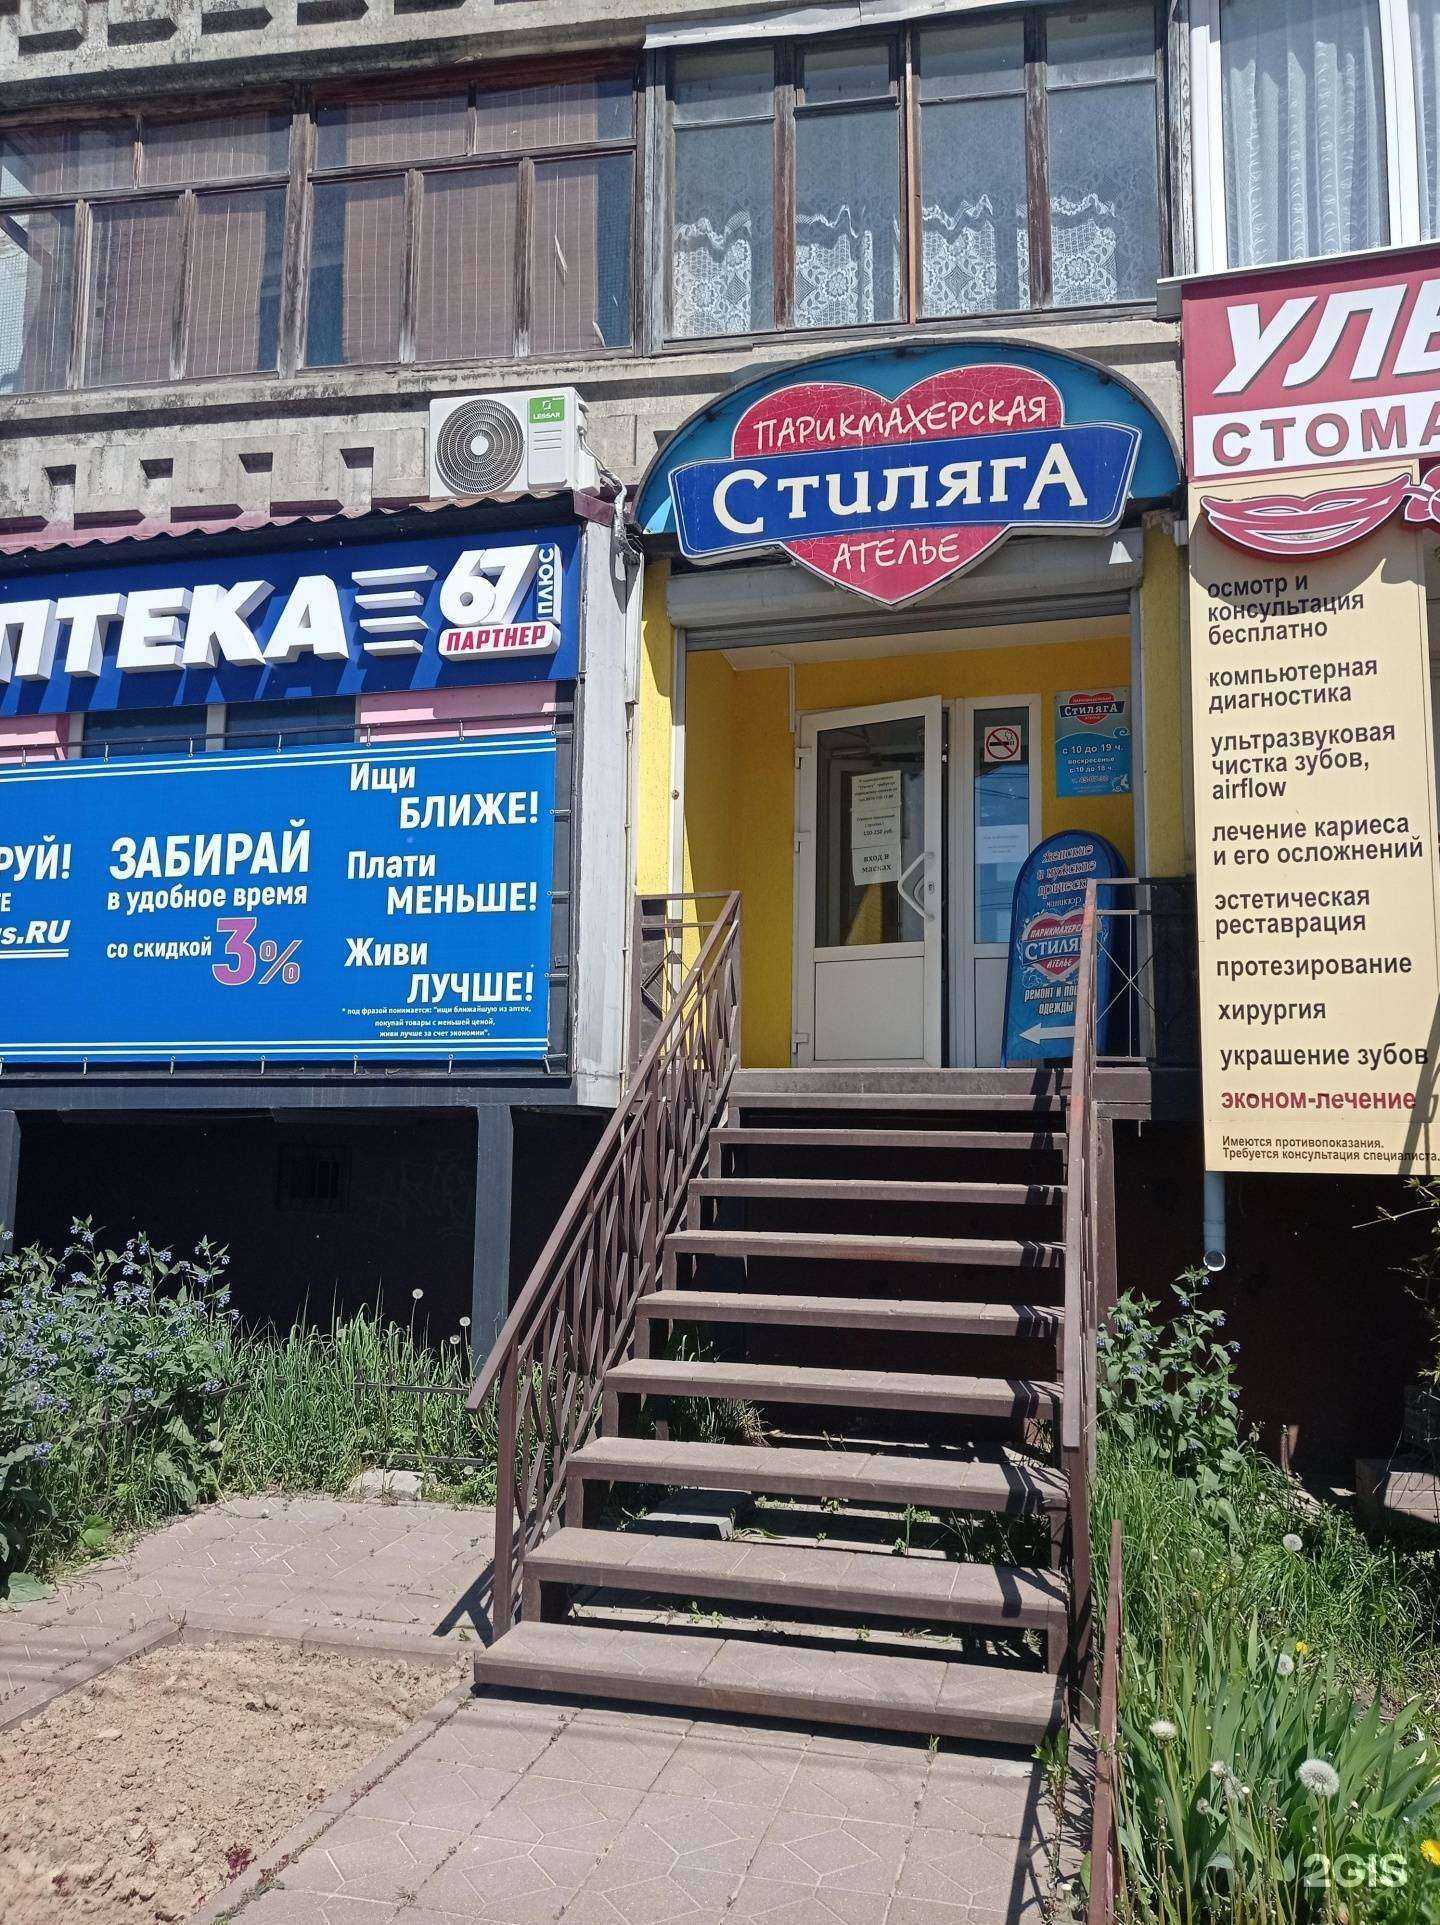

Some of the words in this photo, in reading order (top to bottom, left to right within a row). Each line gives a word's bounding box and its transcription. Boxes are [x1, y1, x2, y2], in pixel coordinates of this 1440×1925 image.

[533, 412, 561, 420] LESSAR
[752, 395, 1048, 451] ПАРИКМАХЕРСКАЯ
[833, 534, 960, 575] АТЕЛЬЕ
[440, 544, 539, 629] 67
[537, 547, 555, 616] ПЛЮС
[1208, 577, 1288, 598] осмотр
[1295, 575, 1308, 591] и
[1208, 593, 1364, 623] консультация
[446, 625, 546, 652] ПАРТНЕР
[1208, 621, 1328, 646] бесплатно
[1209, 659, 1378, 688] компьютерная
[1208, 685, 1352, 714] диагностика
[1071, 746, 1082, 754] 10
[1085, 746, 1098, 755] до
[1101, 744, 1112, 752] 19
[1211, 724, 1396, 757] ультразвуковая
[1212, 755, 1288, 775] чистка
[1295, 748, 1369, 776] зубов,
[350, 762, 416, 794] Ищи
[1212, 778, 1287, 800] airflow
[400, 791, 538, 829] БЛИЖЕ!
[1212, 821, 1307, 842] лечение
[1315, 816, 1409, 841] кариеса
[109, 818, 311, 881] ЗАБИРАЙ
[1213, 850, 1226, 866] и
[1234, 848, 1270, 865] его
[1277, 836, 1423, 863] осложнений
[347, 850, 436, 879] Плати
[107, 891, 120, 911] в
[126, 883, 227, 916] удобное
[233, 885, 308, 912] время
[387, 882, 537, 915] МЕНЬШЕ!
[1214, 887, 1371, 911] эстетическая
[0, 919, 72, 945] s.RU
[1030, 923, 1083, 938] ПАРИКМАХЕРС
[1215, 913, 1366, 939] реставрация
[106, 941, 129, 959] со
[133, 936, 212, 960] скидкой
[211, 916, 303, 986] 3%
[344, 938, 428, 968] Живи
[1024, 937, 1081, 961] СТИЛЯ
[1216, 955, 1412, 981] протезирование
[406, 971, 534, 1004] ЛУЧШЕ!
[347, 1008, 361, 1016] под
[361, 1006, 387, 1016] фразой
[388, 1006, 433, 1015] понимается:
[453, 1005, 498, 1015] ближайшую
[498, 1005, 508, 1013] из
[508, 1005, 532, 1014] аптек,
[374, 1018, 404, 1028] покупай
[405, 1019, 431, 1027] товары
[437, 1018, 470, 1026] меньшей
[471, 1018, 496, 1027] ценой,
[1218, 1001, 1327, 1025] хирургия
[400, 1031, 424, 1039] лучше
[1220, 1046, 1350, 1070] украшение
[1357, 1042, 1429, 1070] зубов
[1221, 1090, 1417, 1109] эконом-лечение
[1222, 1135, 1272, 1148] Имеются
[1275, 1138, 1384, 1149] противопоказания.
[1223, 1147, 1279, 1161] Требуется
[1282, 1150, 1360, 1162] консультация
[1363, 1151, 1440, 1162] специалиста.
